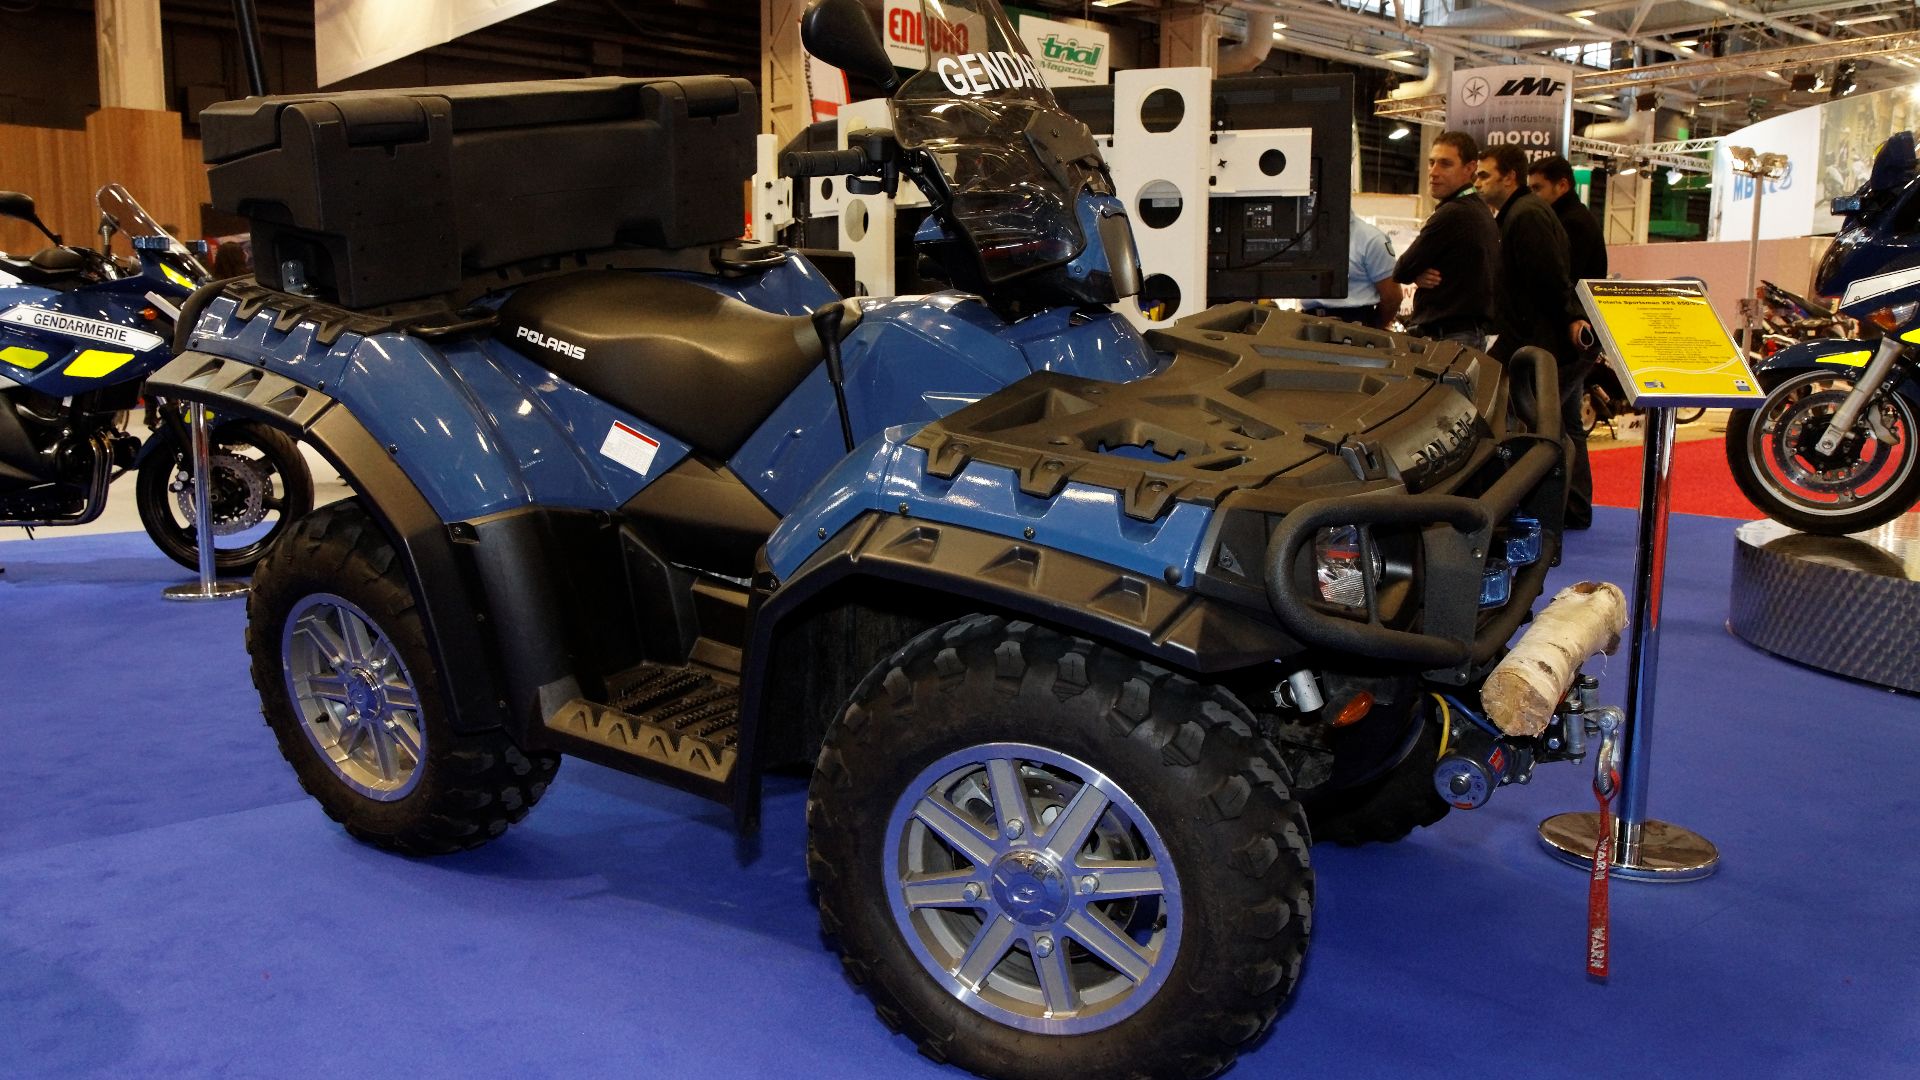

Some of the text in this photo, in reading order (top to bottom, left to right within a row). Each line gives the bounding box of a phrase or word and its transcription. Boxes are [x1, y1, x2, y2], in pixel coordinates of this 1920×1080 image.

[1041, 36, 1102, 66] trial
[1040, 61, 1095, 77] Magazine
[1487, 130, 1550, 146] MOTOS
[33, 313, 128, 342] GENDARMERIE
[516, 325, 587, 361] POLARIS
[1594, 836, 1609, 880] WARN
[1590, 926, 1606, 969] WARN
